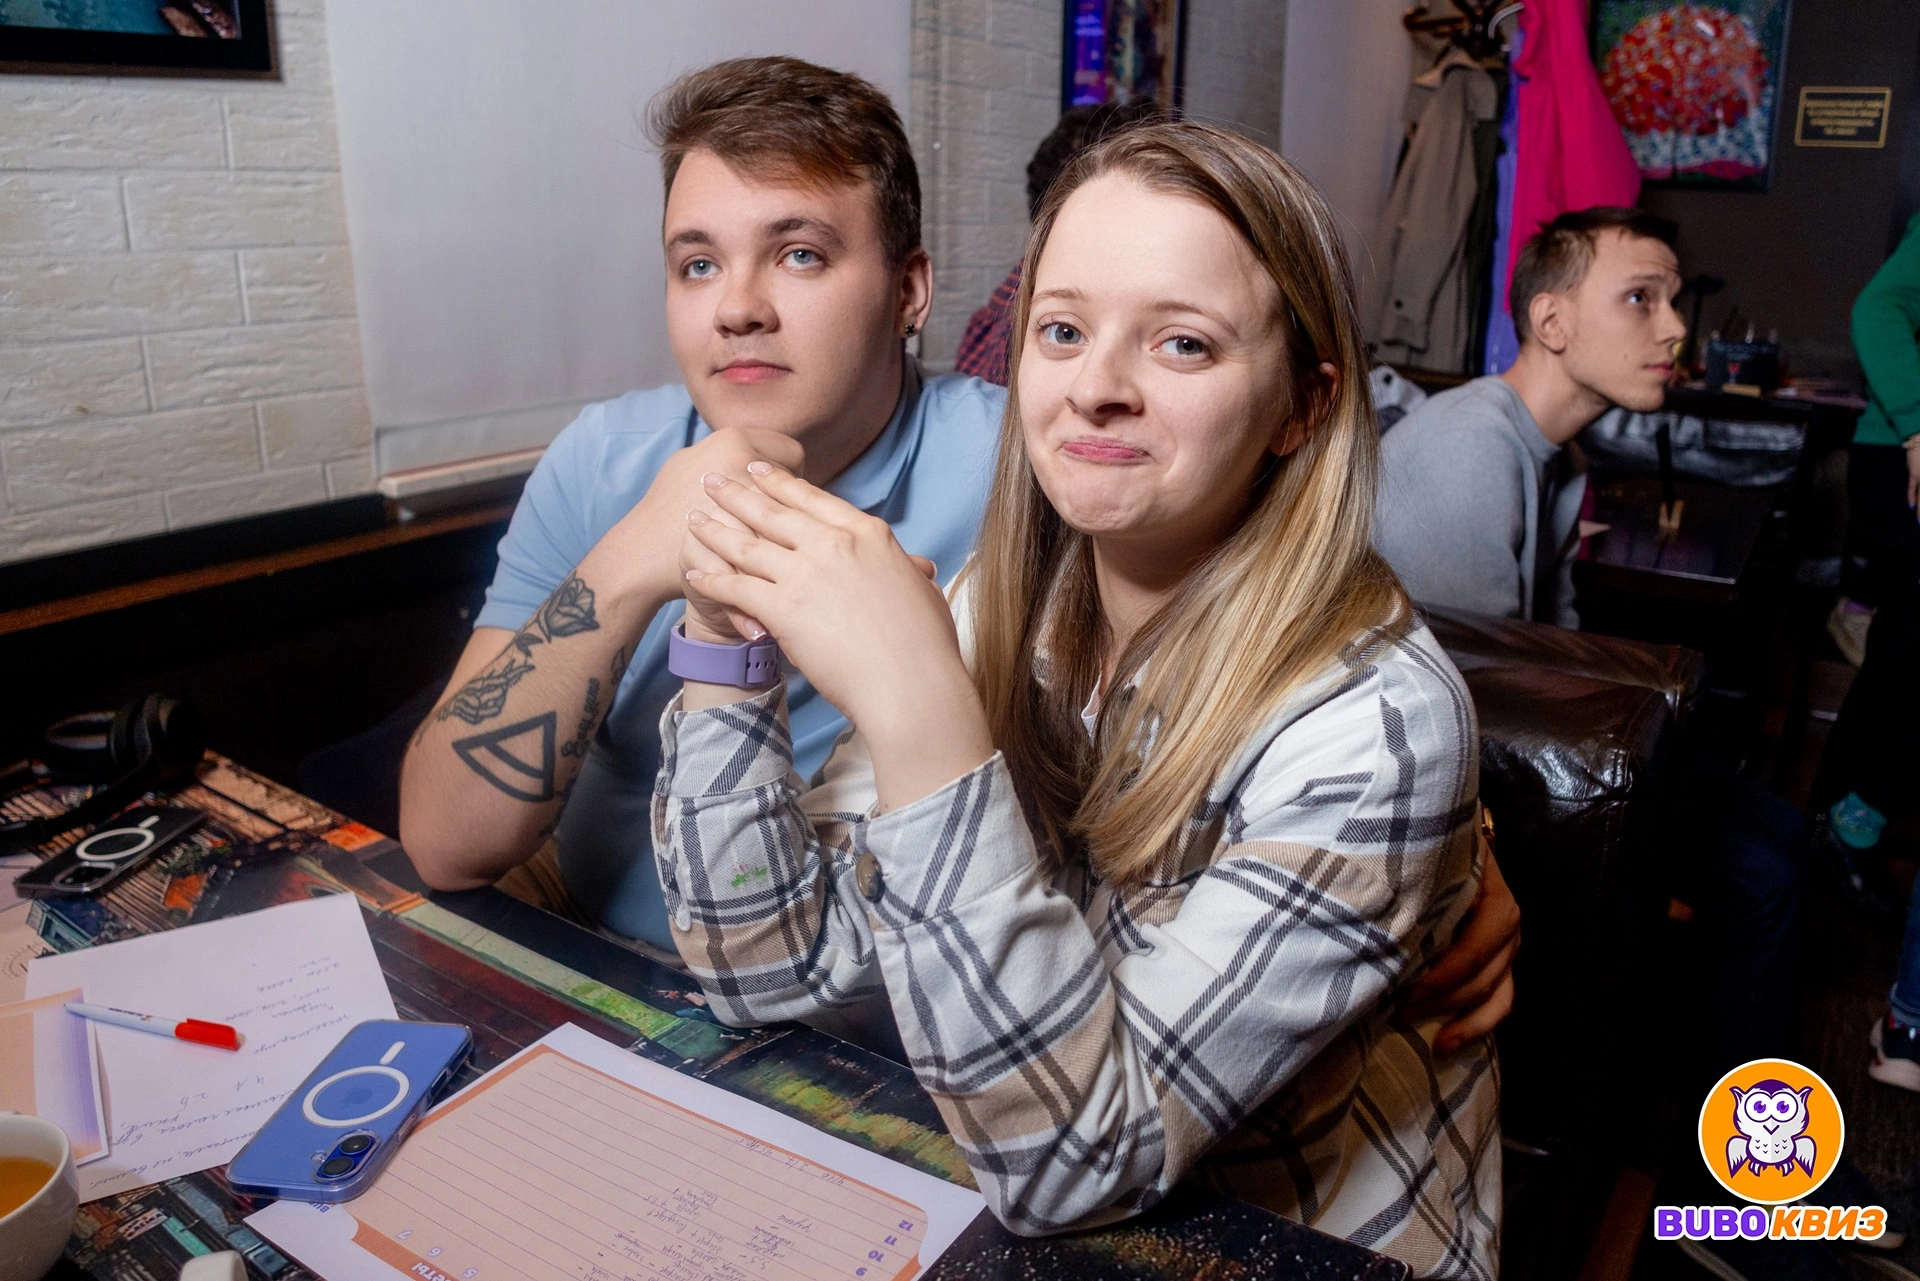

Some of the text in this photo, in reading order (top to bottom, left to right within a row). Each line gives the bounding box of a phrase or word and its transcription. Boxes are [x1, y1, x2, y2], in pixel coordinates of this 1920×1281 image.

[898, 1219, 915, 1232] 12
[396, 1229, 412, 1240] 7
[884, 1235, 898, 1246] 11
[426, 1246, 441, 1257] 6
[868, 1250, 884, 1263] 10
[462, 1267, 478, 1279] 5
[855, 1267, 868, 1277] 9
